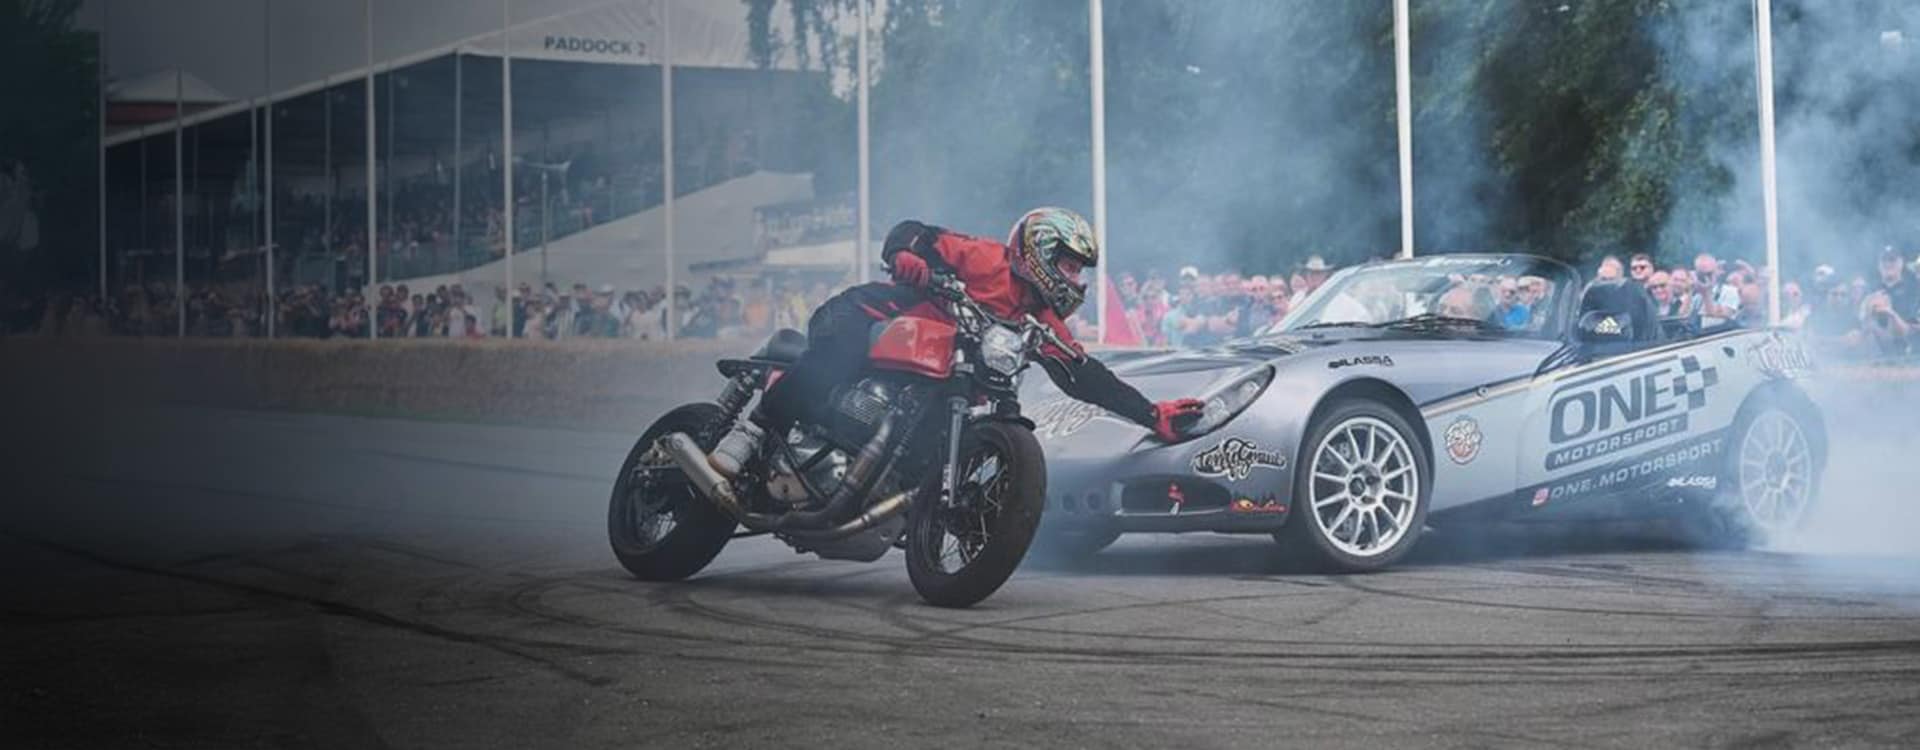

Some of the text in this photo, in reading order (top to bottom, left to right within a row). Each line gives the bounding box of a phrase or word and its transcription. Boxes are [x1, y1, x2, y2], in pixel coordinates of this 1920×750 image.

[544, 35, 632, 54] PADDOCK
[1551, 369, 1680, 443] ONE
[1551, 439, 1722, 498] ONE.MOTORSPORT
[1554, 419, 1680, 466] MOTORSPORT
